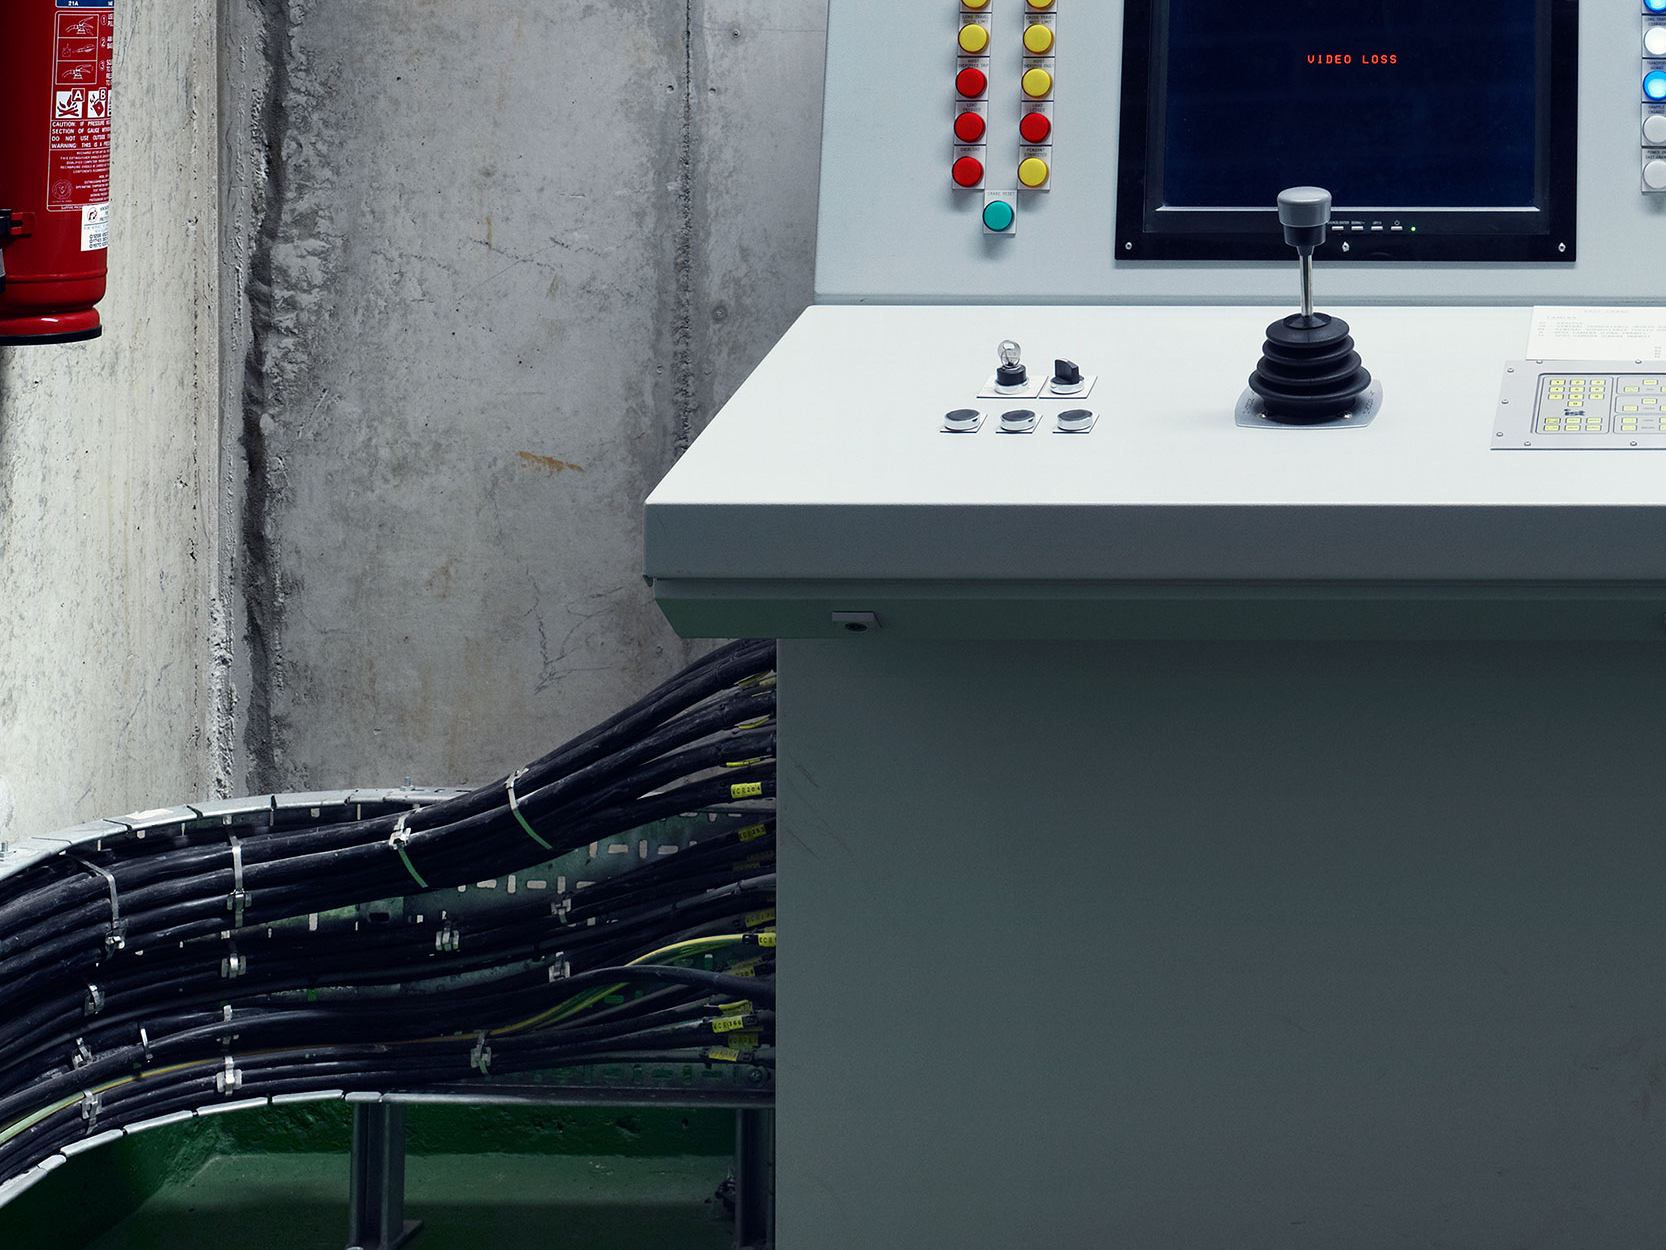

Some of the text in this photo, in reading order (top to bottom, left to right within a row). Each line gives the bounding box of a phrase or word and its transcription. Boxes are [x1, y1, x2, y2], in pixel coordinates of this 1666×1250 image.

[1307, 54, 1398, 64] VIDEO LOSS
[73, 90, 83, 100] A
